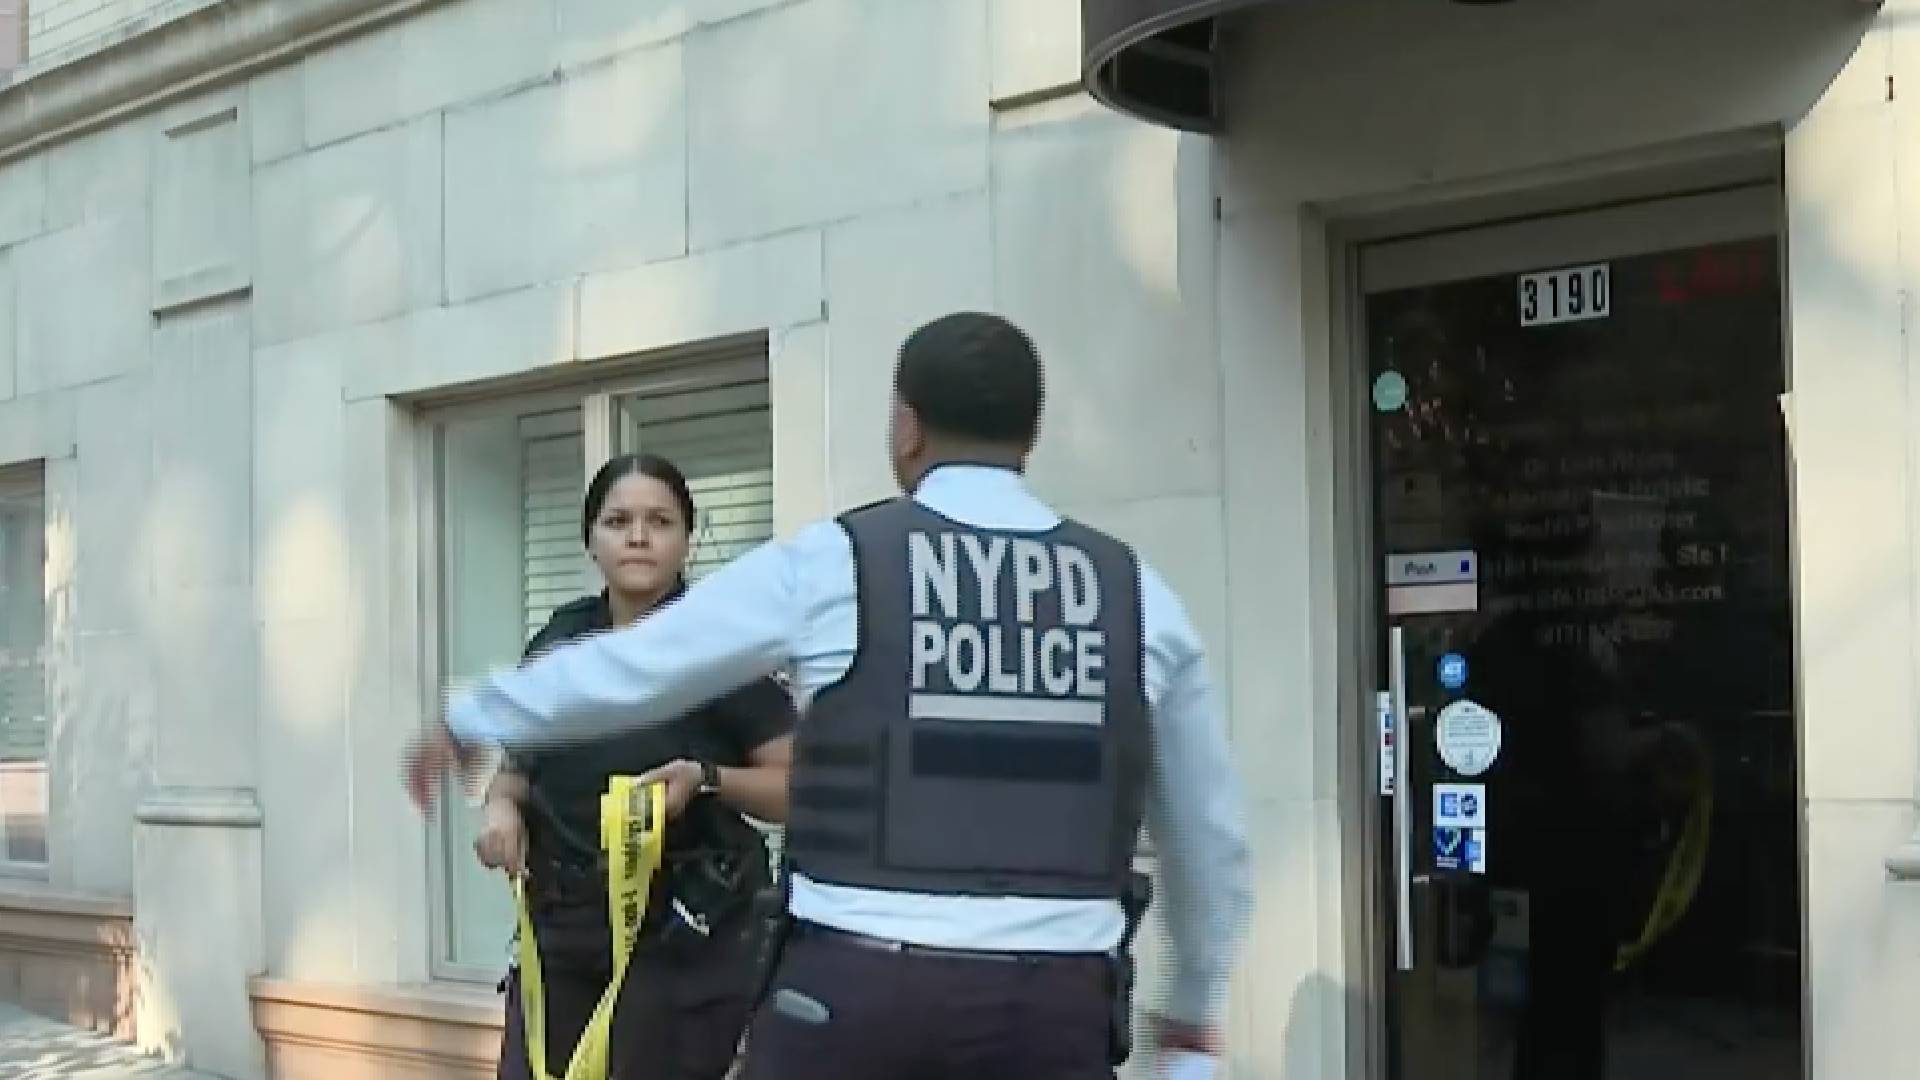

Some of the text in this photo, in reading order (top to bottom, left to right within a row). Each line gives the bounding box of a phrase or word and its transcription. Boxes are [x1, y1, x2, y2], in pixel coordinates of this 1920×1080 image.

[1523, 269, 1606, 321] 3190
[909, 531, 1101, 626] NYPD
[911, 620, 1106, 697] POLICE
